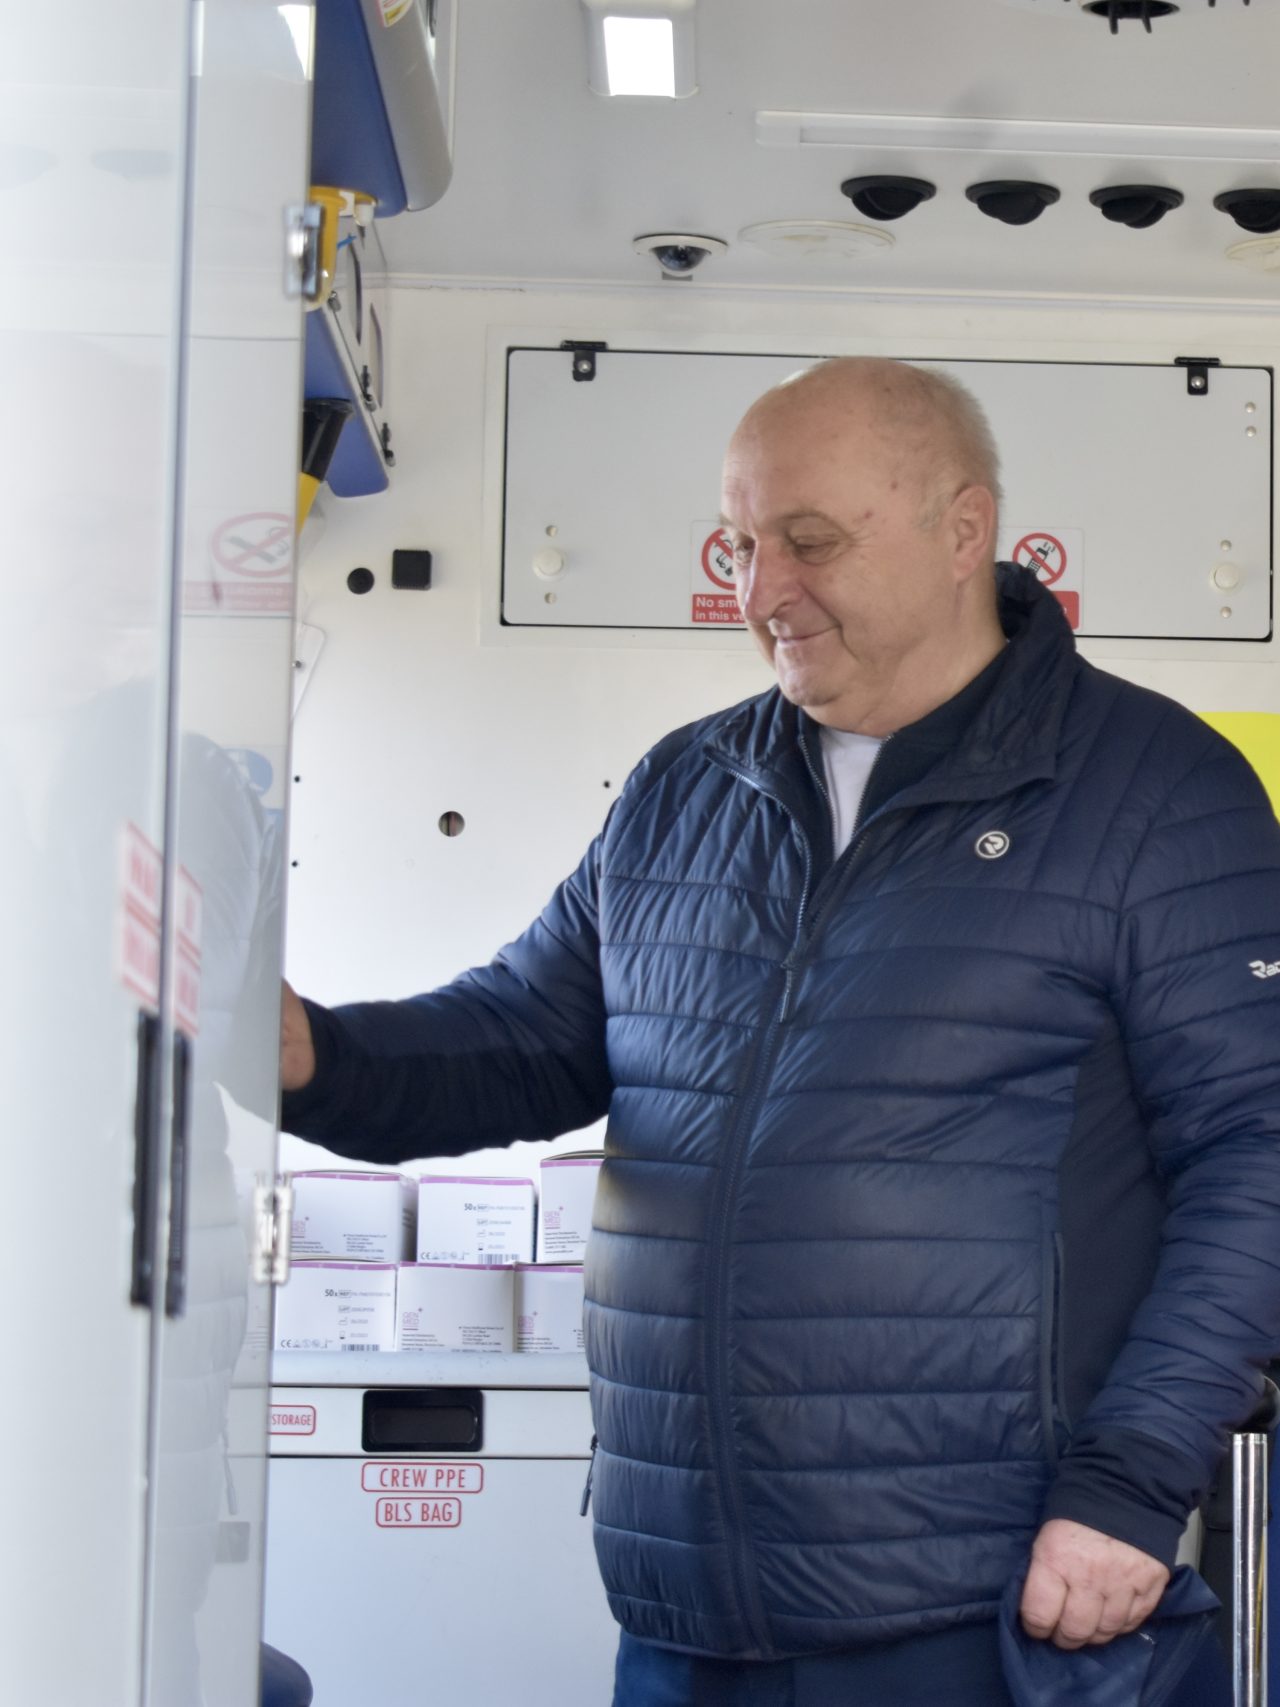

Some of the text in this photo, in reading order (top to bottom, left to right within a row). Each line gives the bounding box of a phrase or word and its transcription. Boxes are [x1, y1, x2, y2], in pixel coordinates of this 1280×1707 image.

[696, 596, 714, 608] No
[695, 610, 706, 620] in
[709, 610, 729, 621] this
[271, 1413, 312, 1426] STORAGE
[379, 1467, 466, 1488] CREW PPE
[384, 1502, 453, 1522] BLS BAG
